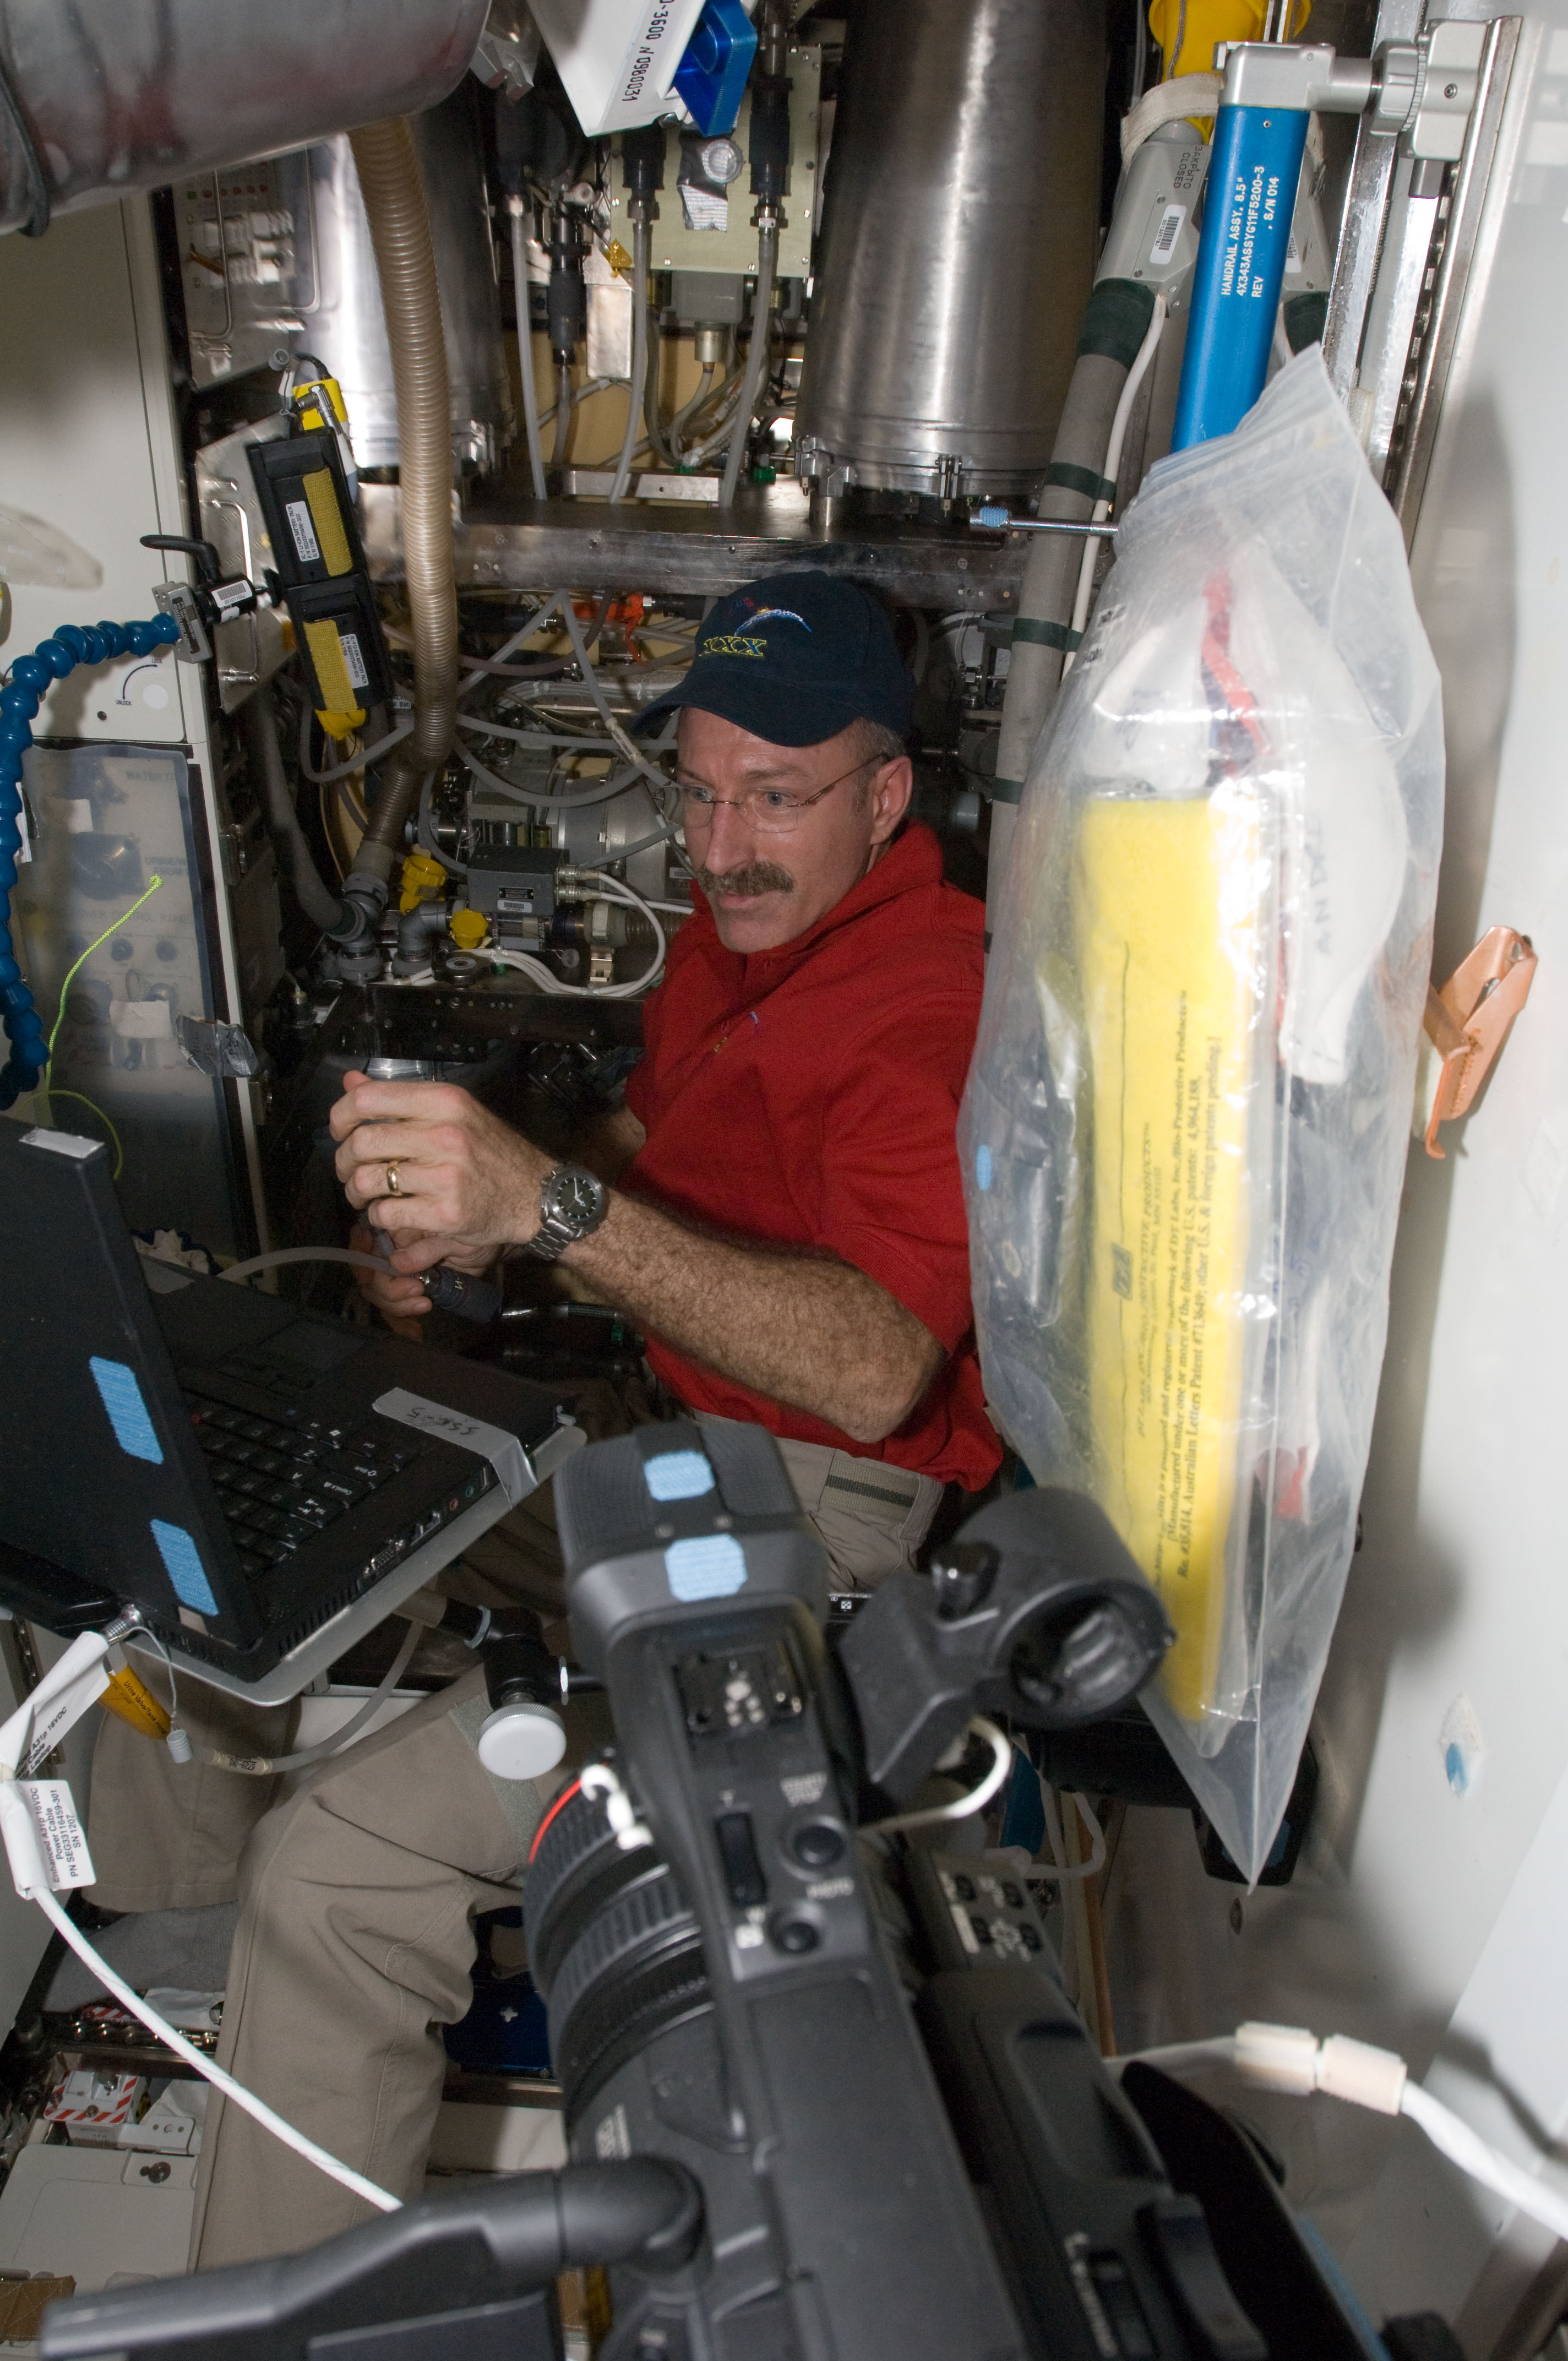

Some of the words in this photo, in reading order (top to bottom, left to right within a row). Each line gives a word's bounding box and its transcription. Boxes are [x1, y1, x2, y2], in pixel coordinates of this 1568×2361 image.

[1173, 153, 1190, 188] CLOSED
[1267, 177, 1279, 196] 014
[1264, 199, 1276, 220] S/N
[1237, 166, 1264, 296] 4X343ASSYG11F5200-3
[1221, 243, 1237, 295] HANDRAIL
[1251, 276, 1263, 297] REV
[291, 518, 300, 536] BATTERY
[1202, 1103, 1221, 1154] patents
[1185, 1149, 1200, 1202] patents:
[1199, 1155, 1217, 1202] foreign
[1182, 1205, 1195, 1232] U.S.
[1196, 1221, 1211, 1249] U.S.
[1179, 1233, 1196, 1294] following
[1195, 1252, 1209, 1286] other
[1178, 1296, 1190, 1316] the
[1177, 1317, 1189, 1332] of
[1179, 1334, 1189, 1367] more
[1178, 1369, 1186, 1385] or
[1189, 1350, 1204, 1390] Patent
[1176, 1388, 1185, 1409] one
[1185, 1393, 1201, 1436] Letters
[1172, 1412, 1184, 1450] under
[292, 1472, 302, 1480] A
[1182, 1441, 1197, 1505] Australian
[123, 1680, 136, 1696] Urine
[134, 1695, 156, 1721] Valve/Tank
[32, 1731, 47, 1749] A31p
[28, 1743, 45, 1764] Cable
[31, 1745, 52, 1769] Laptop
[38, 1818, 48, 1838] A31p
[46, 1808, 56, 1831] Cable
[51, 1790, 74, 1862] SEG33116459-301
[67, 1815, 77, 1832] 1207
[52, 1835, 63, 1859] Power
[72, 1836, 80, 1847] SN
[43, 1841, 59, 1883] Enhanced
[69, 1864, 78, 1876] PN
